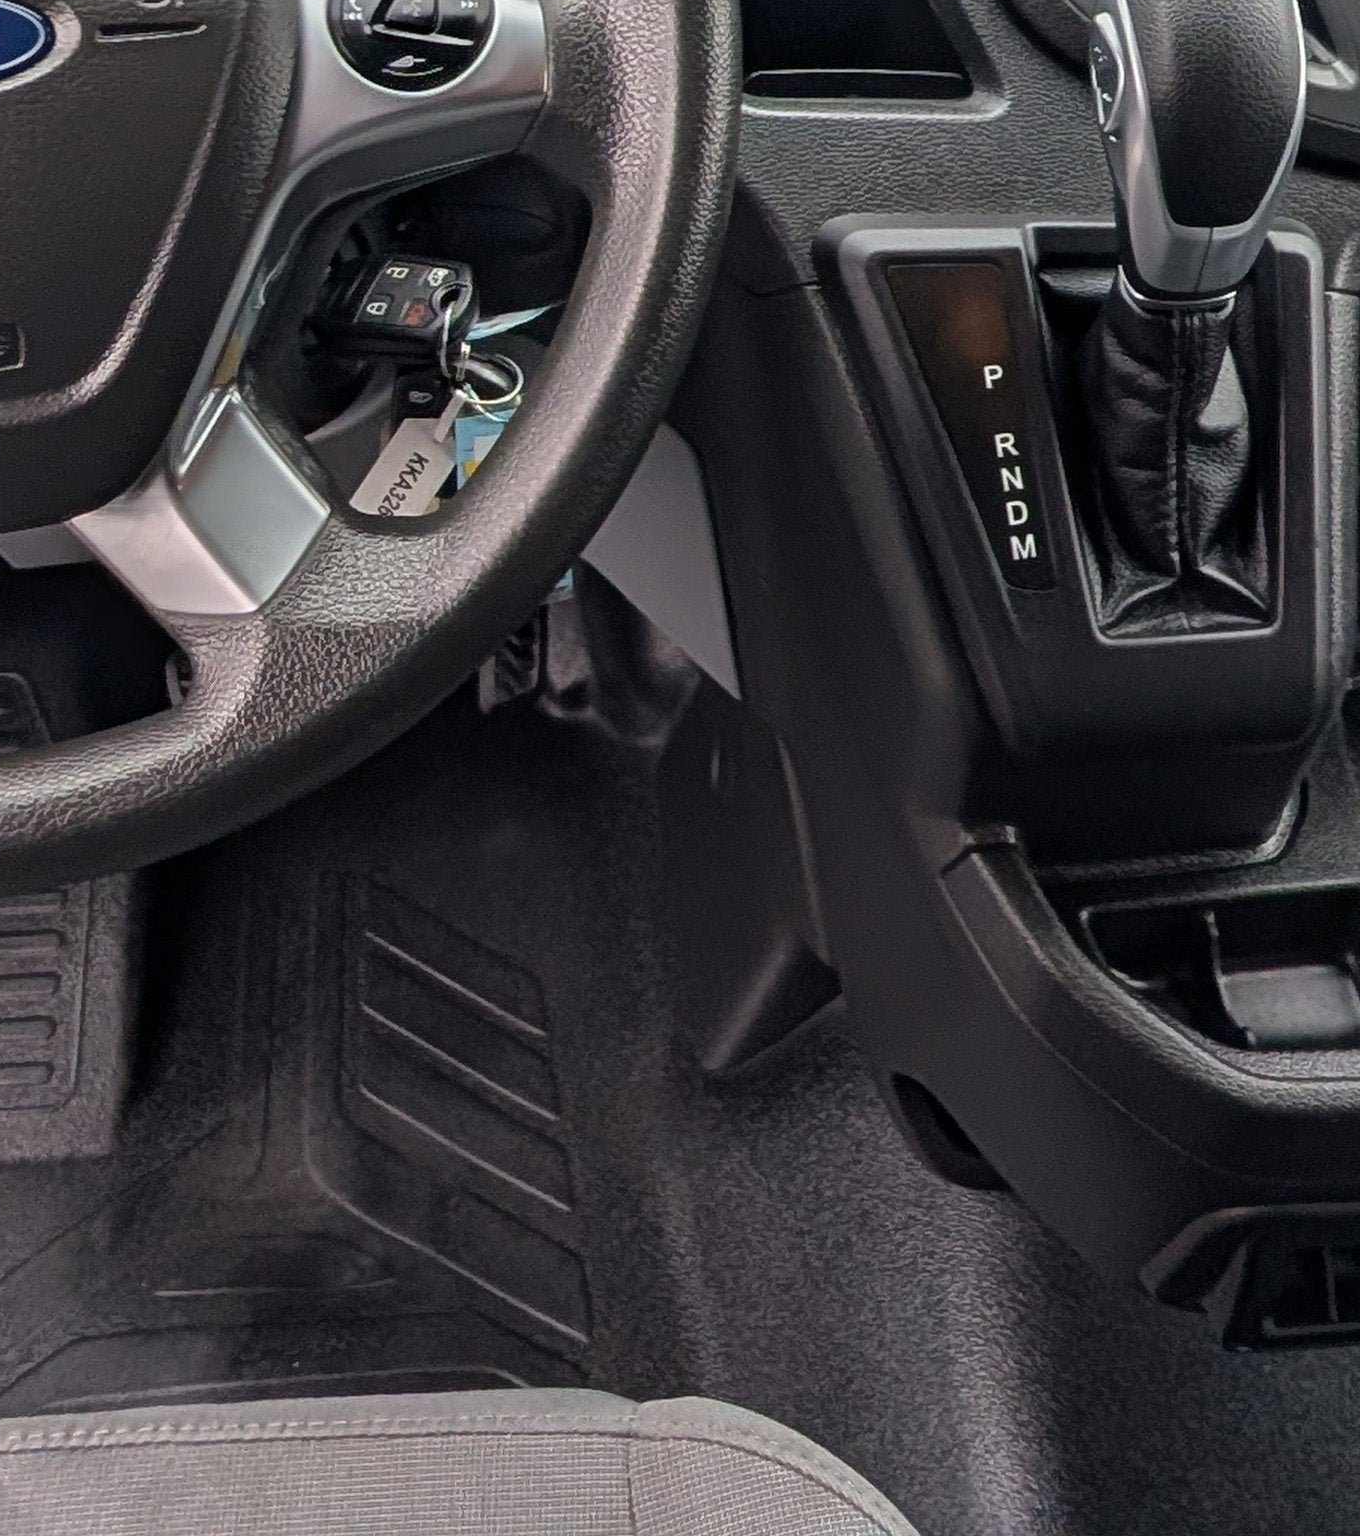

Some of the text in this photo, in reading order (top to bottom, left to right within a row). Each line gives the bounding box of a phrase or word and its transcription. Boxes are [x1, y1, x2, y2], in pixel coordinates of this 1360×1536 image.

[983, 364, 1004, 389] P
[994, 432, 1020, 458] R
[1000, 465, 1025, 493] N
[1005, 500, 1029, 526] D
[1009, 533, 1037, 561] M
